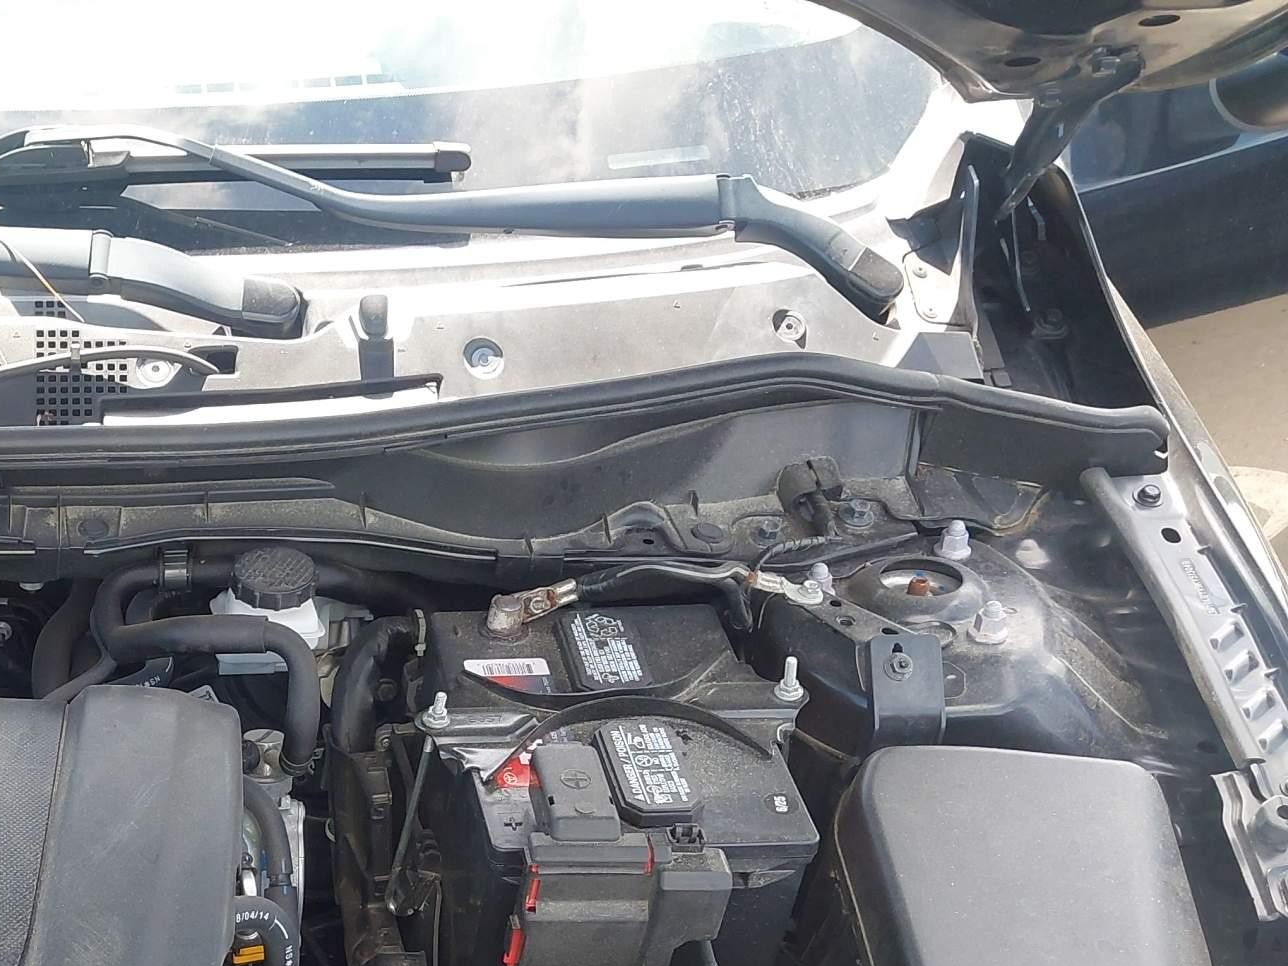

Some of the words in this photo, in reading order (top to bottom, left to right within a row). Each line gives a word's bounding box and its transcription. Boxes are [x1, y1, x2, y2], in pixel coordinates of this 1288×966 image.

[609, 730, 628, 757] POISON
[622, 764, 644, 794] DANGER
[774, 796, 789, 813] 6/25
